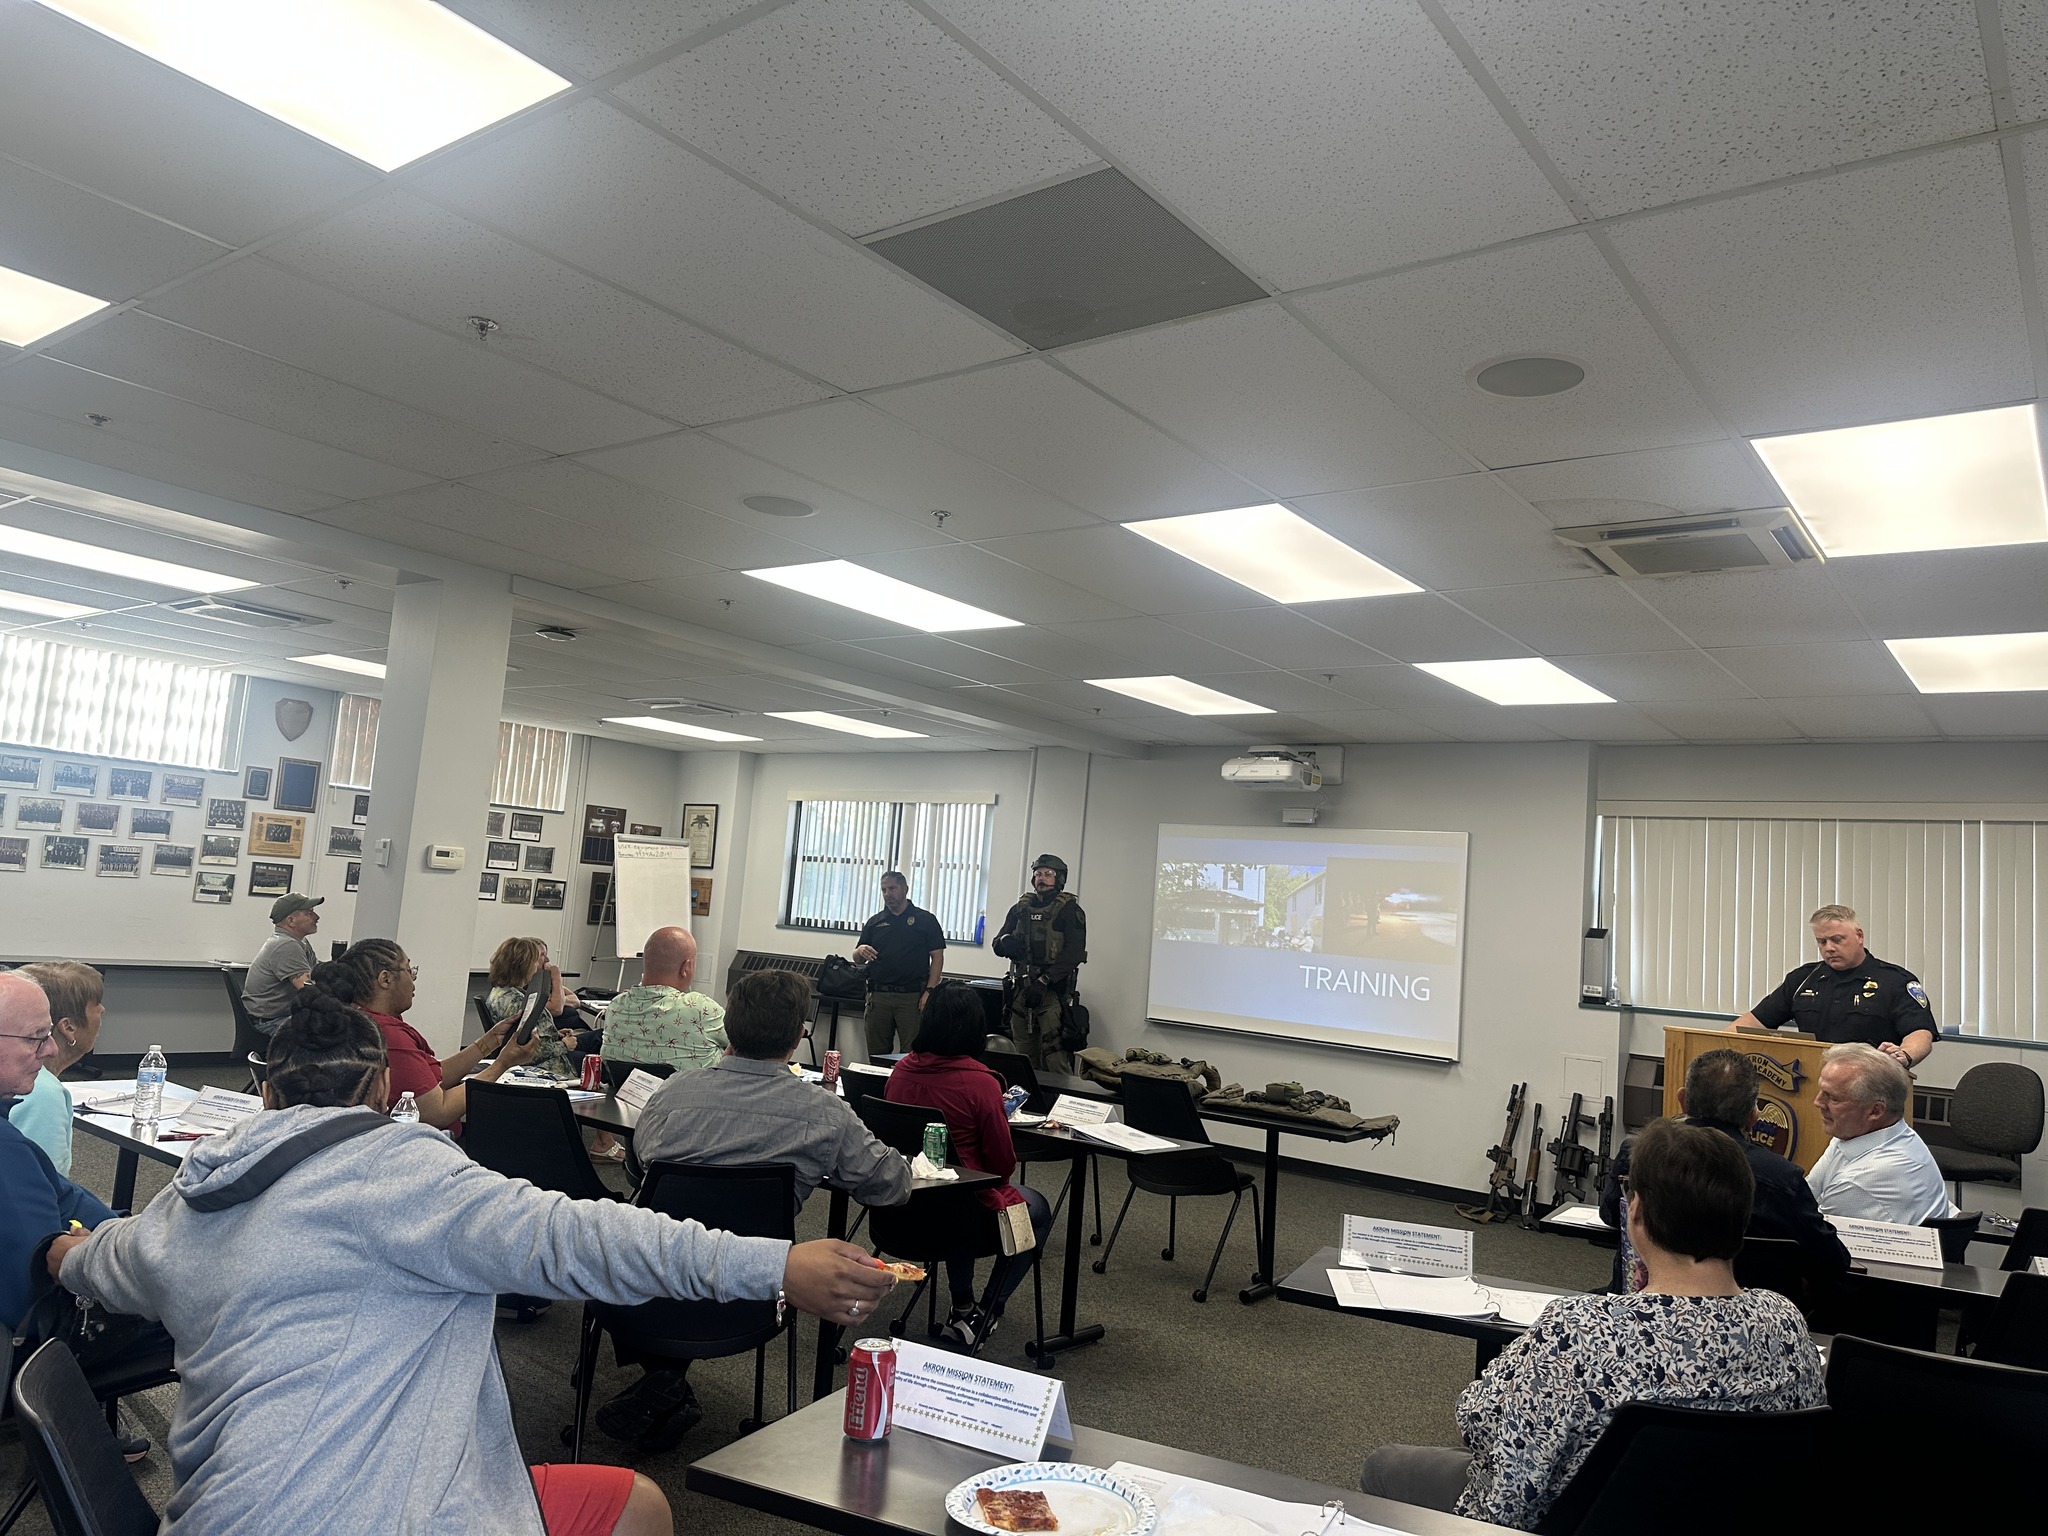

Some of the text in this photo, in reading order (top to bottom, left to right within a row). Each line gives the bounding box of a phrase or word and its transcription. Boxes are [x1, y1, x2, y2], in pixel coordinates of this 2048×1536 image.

[1299, 965, 1430, 1001] TRAINING
[1747, 1055, 1769, 1067] KRON
[1750, 1131, 1775, 1147] LICE
[1372, 1225, 1389, 1234] AKRON
[1391, 1228, 1411, 1236] MISSION
[922, 1361, 1015, 1392] AKRON MISSION STATEMENT:
[936, 1380, 955, 1389] community
[848, 1366, 868, 1430] Friend
